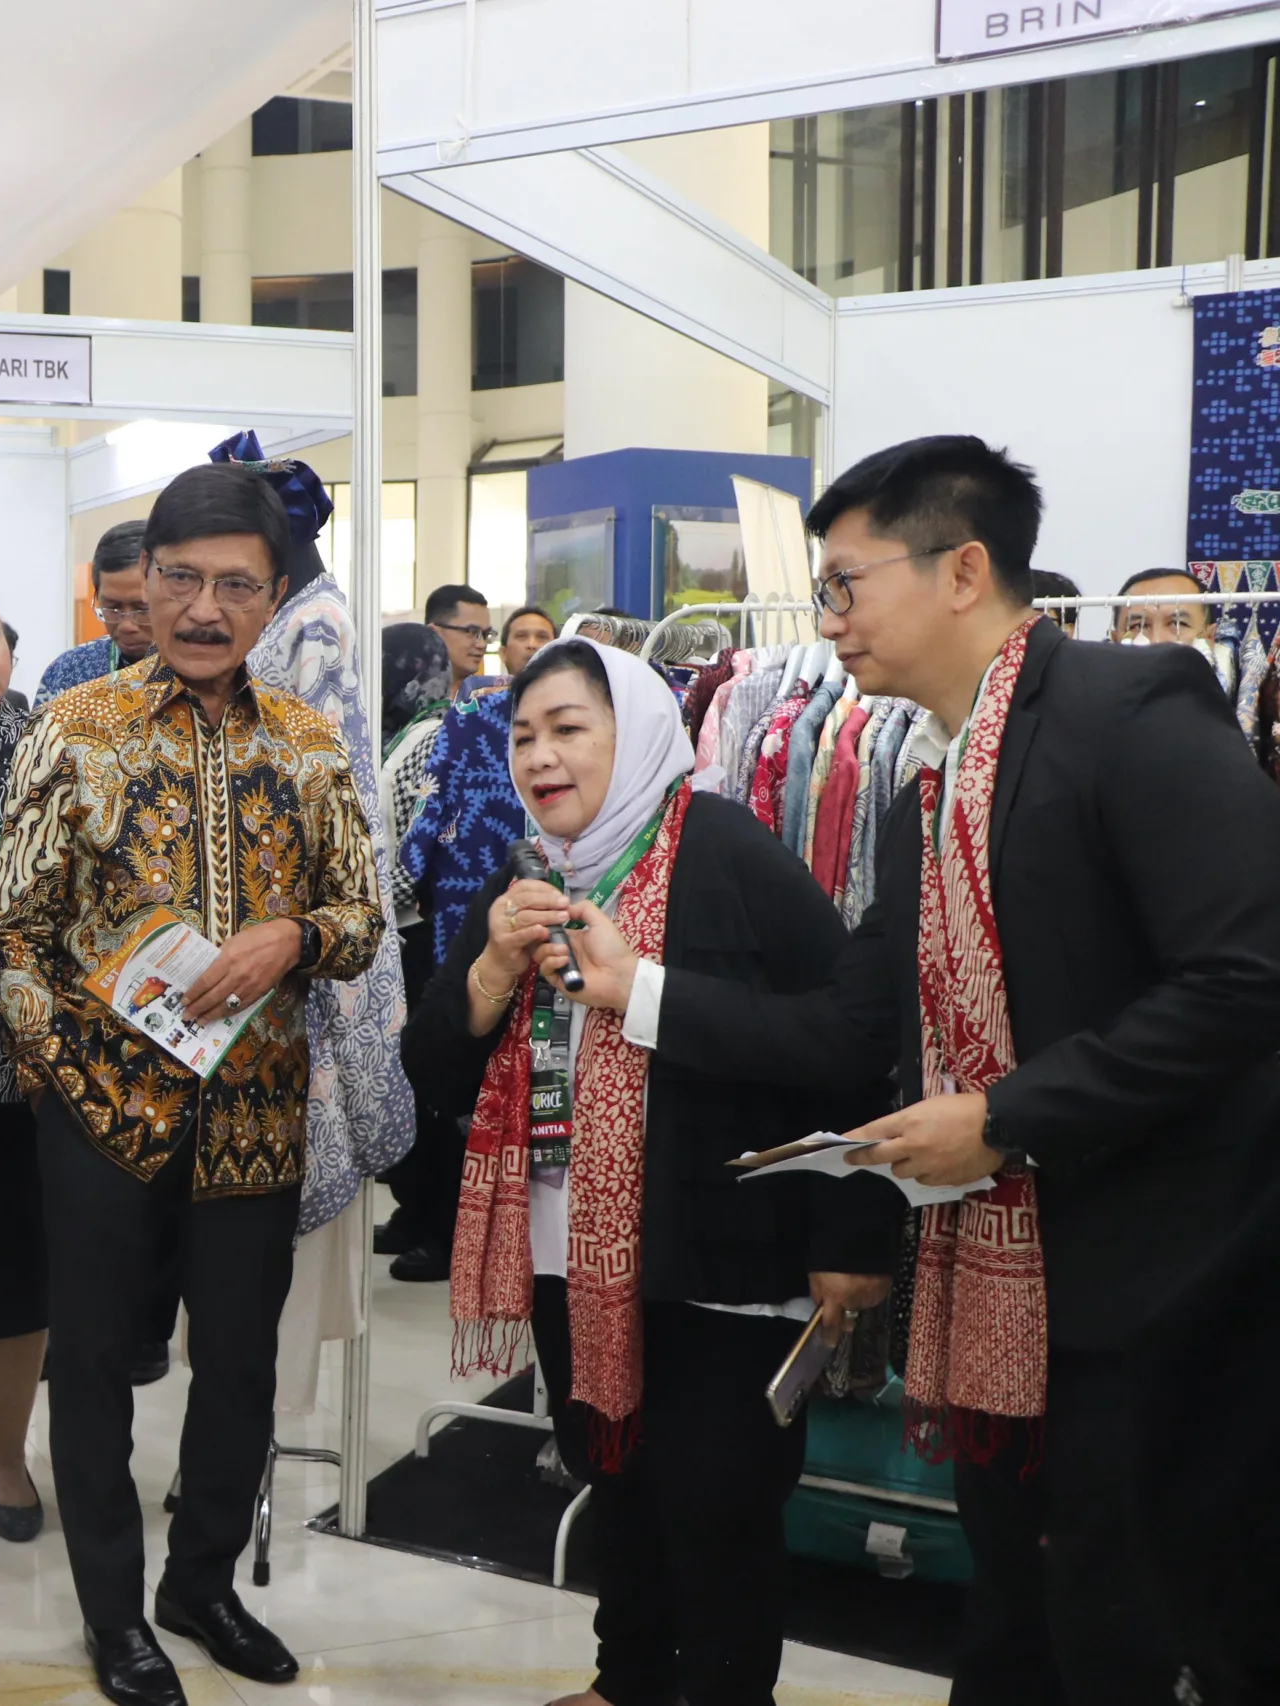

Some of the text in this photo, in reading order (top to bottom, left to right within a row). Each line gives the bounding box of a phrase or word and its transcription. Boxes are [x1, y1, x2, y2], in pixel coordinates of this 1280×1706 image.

[985, 0, 1102, 38] BRIN
[33, 359, 70, 380] TBK
[92, 955, 119, 983] MINYAK
[119, 935, 143, 960] BAKAR
[99, 967, 120, 989] EBT
[531, 1124, 566, 1136] ANITIA
